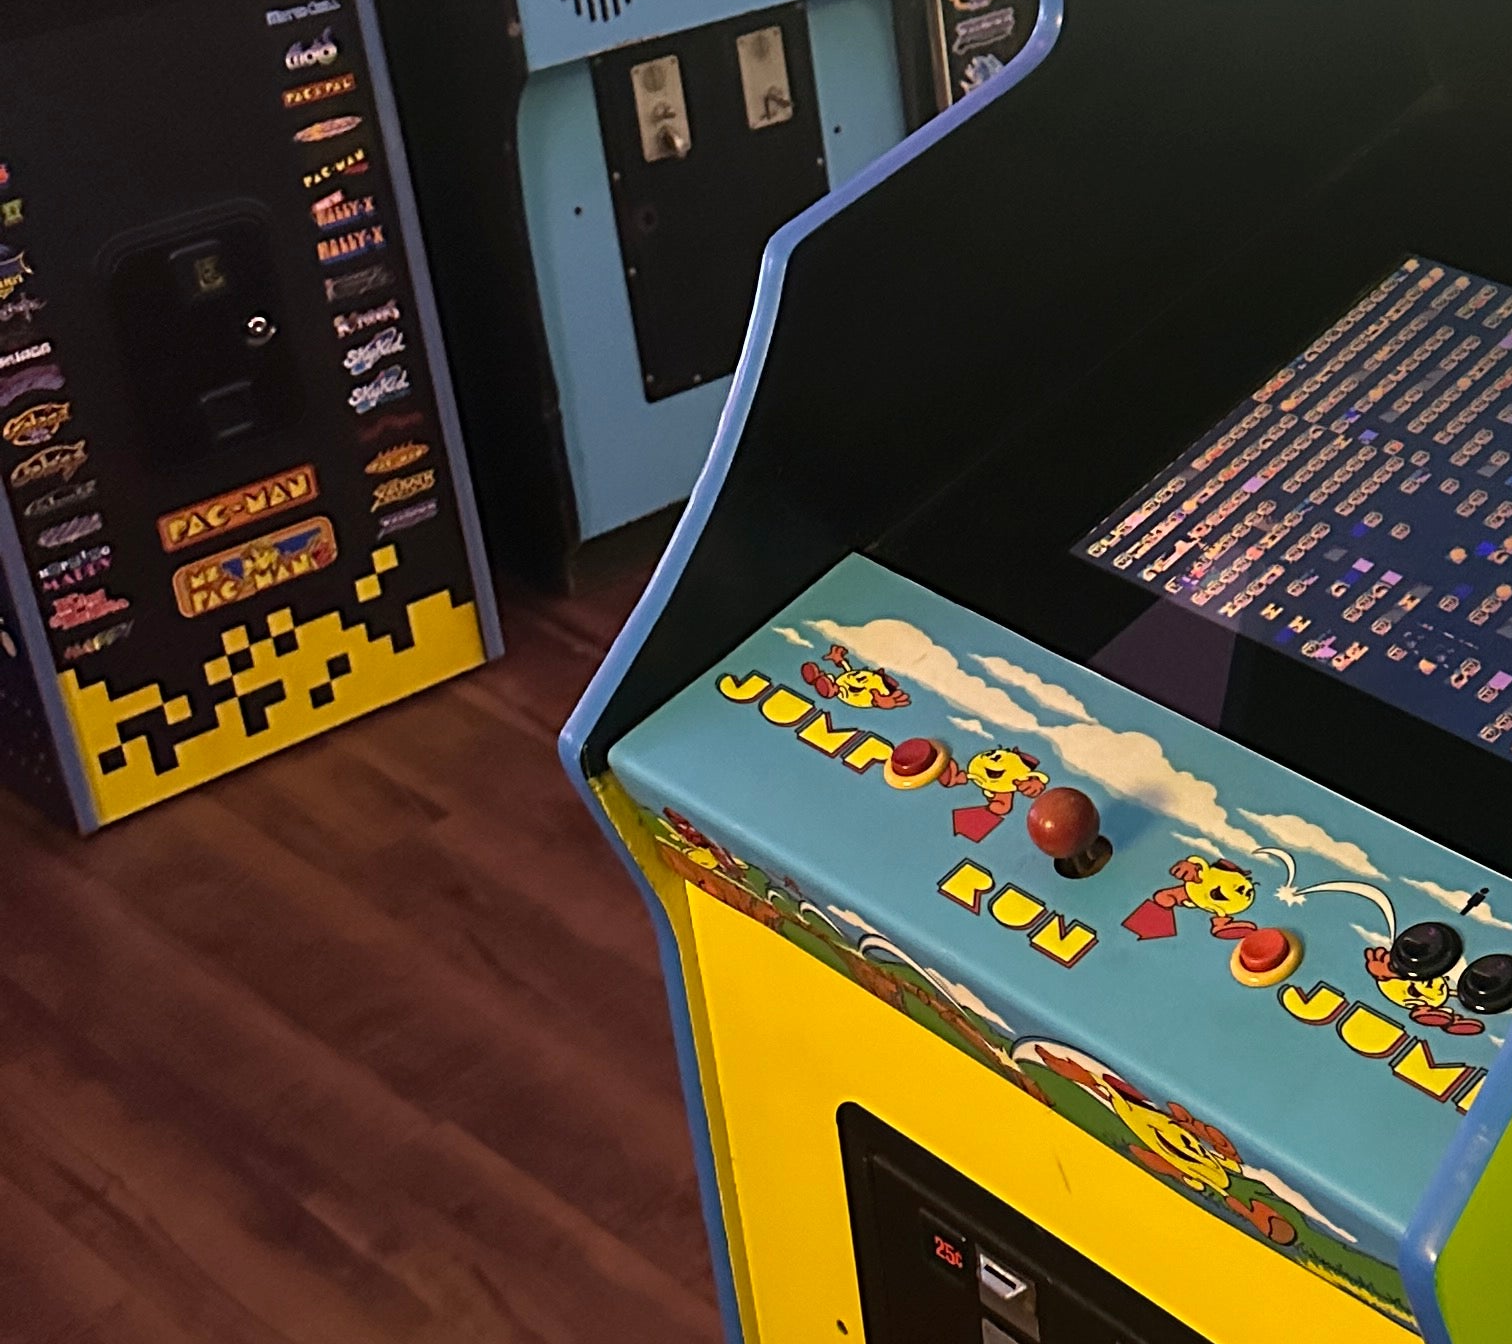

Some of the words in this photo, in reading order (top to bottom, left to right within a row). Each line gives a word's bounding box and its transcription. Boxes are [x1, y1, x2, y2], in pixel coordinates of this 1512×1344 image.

[167, 471, 312, 546] PAC-MAN
[190, 552, 313, 613] PAC-MAN
[715, 669, 897, 774] JUMP
[937, 858, 1099, 969] RUN
[934, 1235, 963, 1269] 25¢
